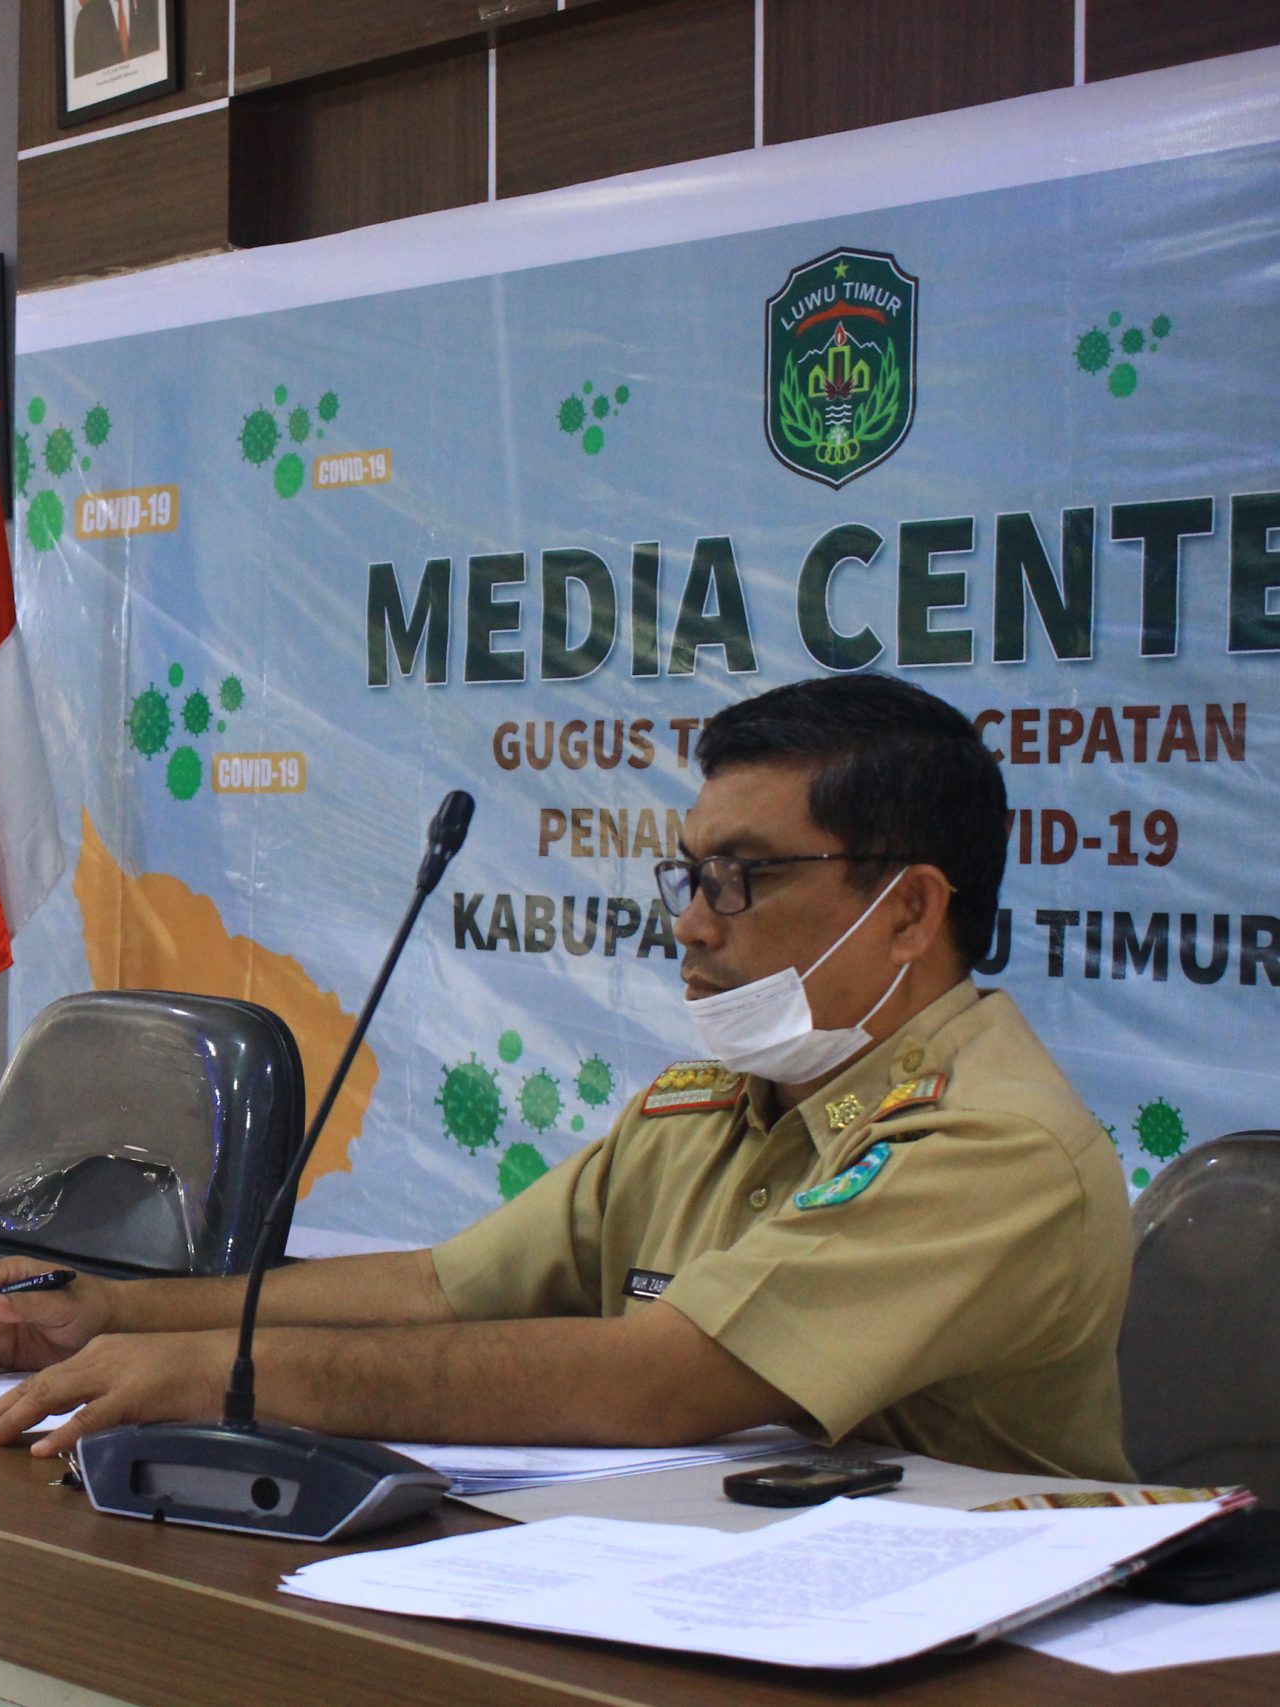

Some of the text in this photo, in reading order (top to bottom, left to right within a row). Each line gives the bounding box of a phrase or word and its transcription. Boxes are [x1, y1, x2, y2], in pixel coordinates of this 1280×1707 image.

[781, 282, 903, 331] LUWU TIMUR
[319, 454, 386, 485] COVID-19
[82, 491, 171, 533] COVID-19
[367, 535, 759, 688] MEDIA
[493, 719, 655, 771] GUGUS
[670, 717, 720, 769] T
[218, 758, 299, 788] COVID-19
[453, 892, 678, 960] KABUPA
[1035, 909, 1280, 987] TIMUR
